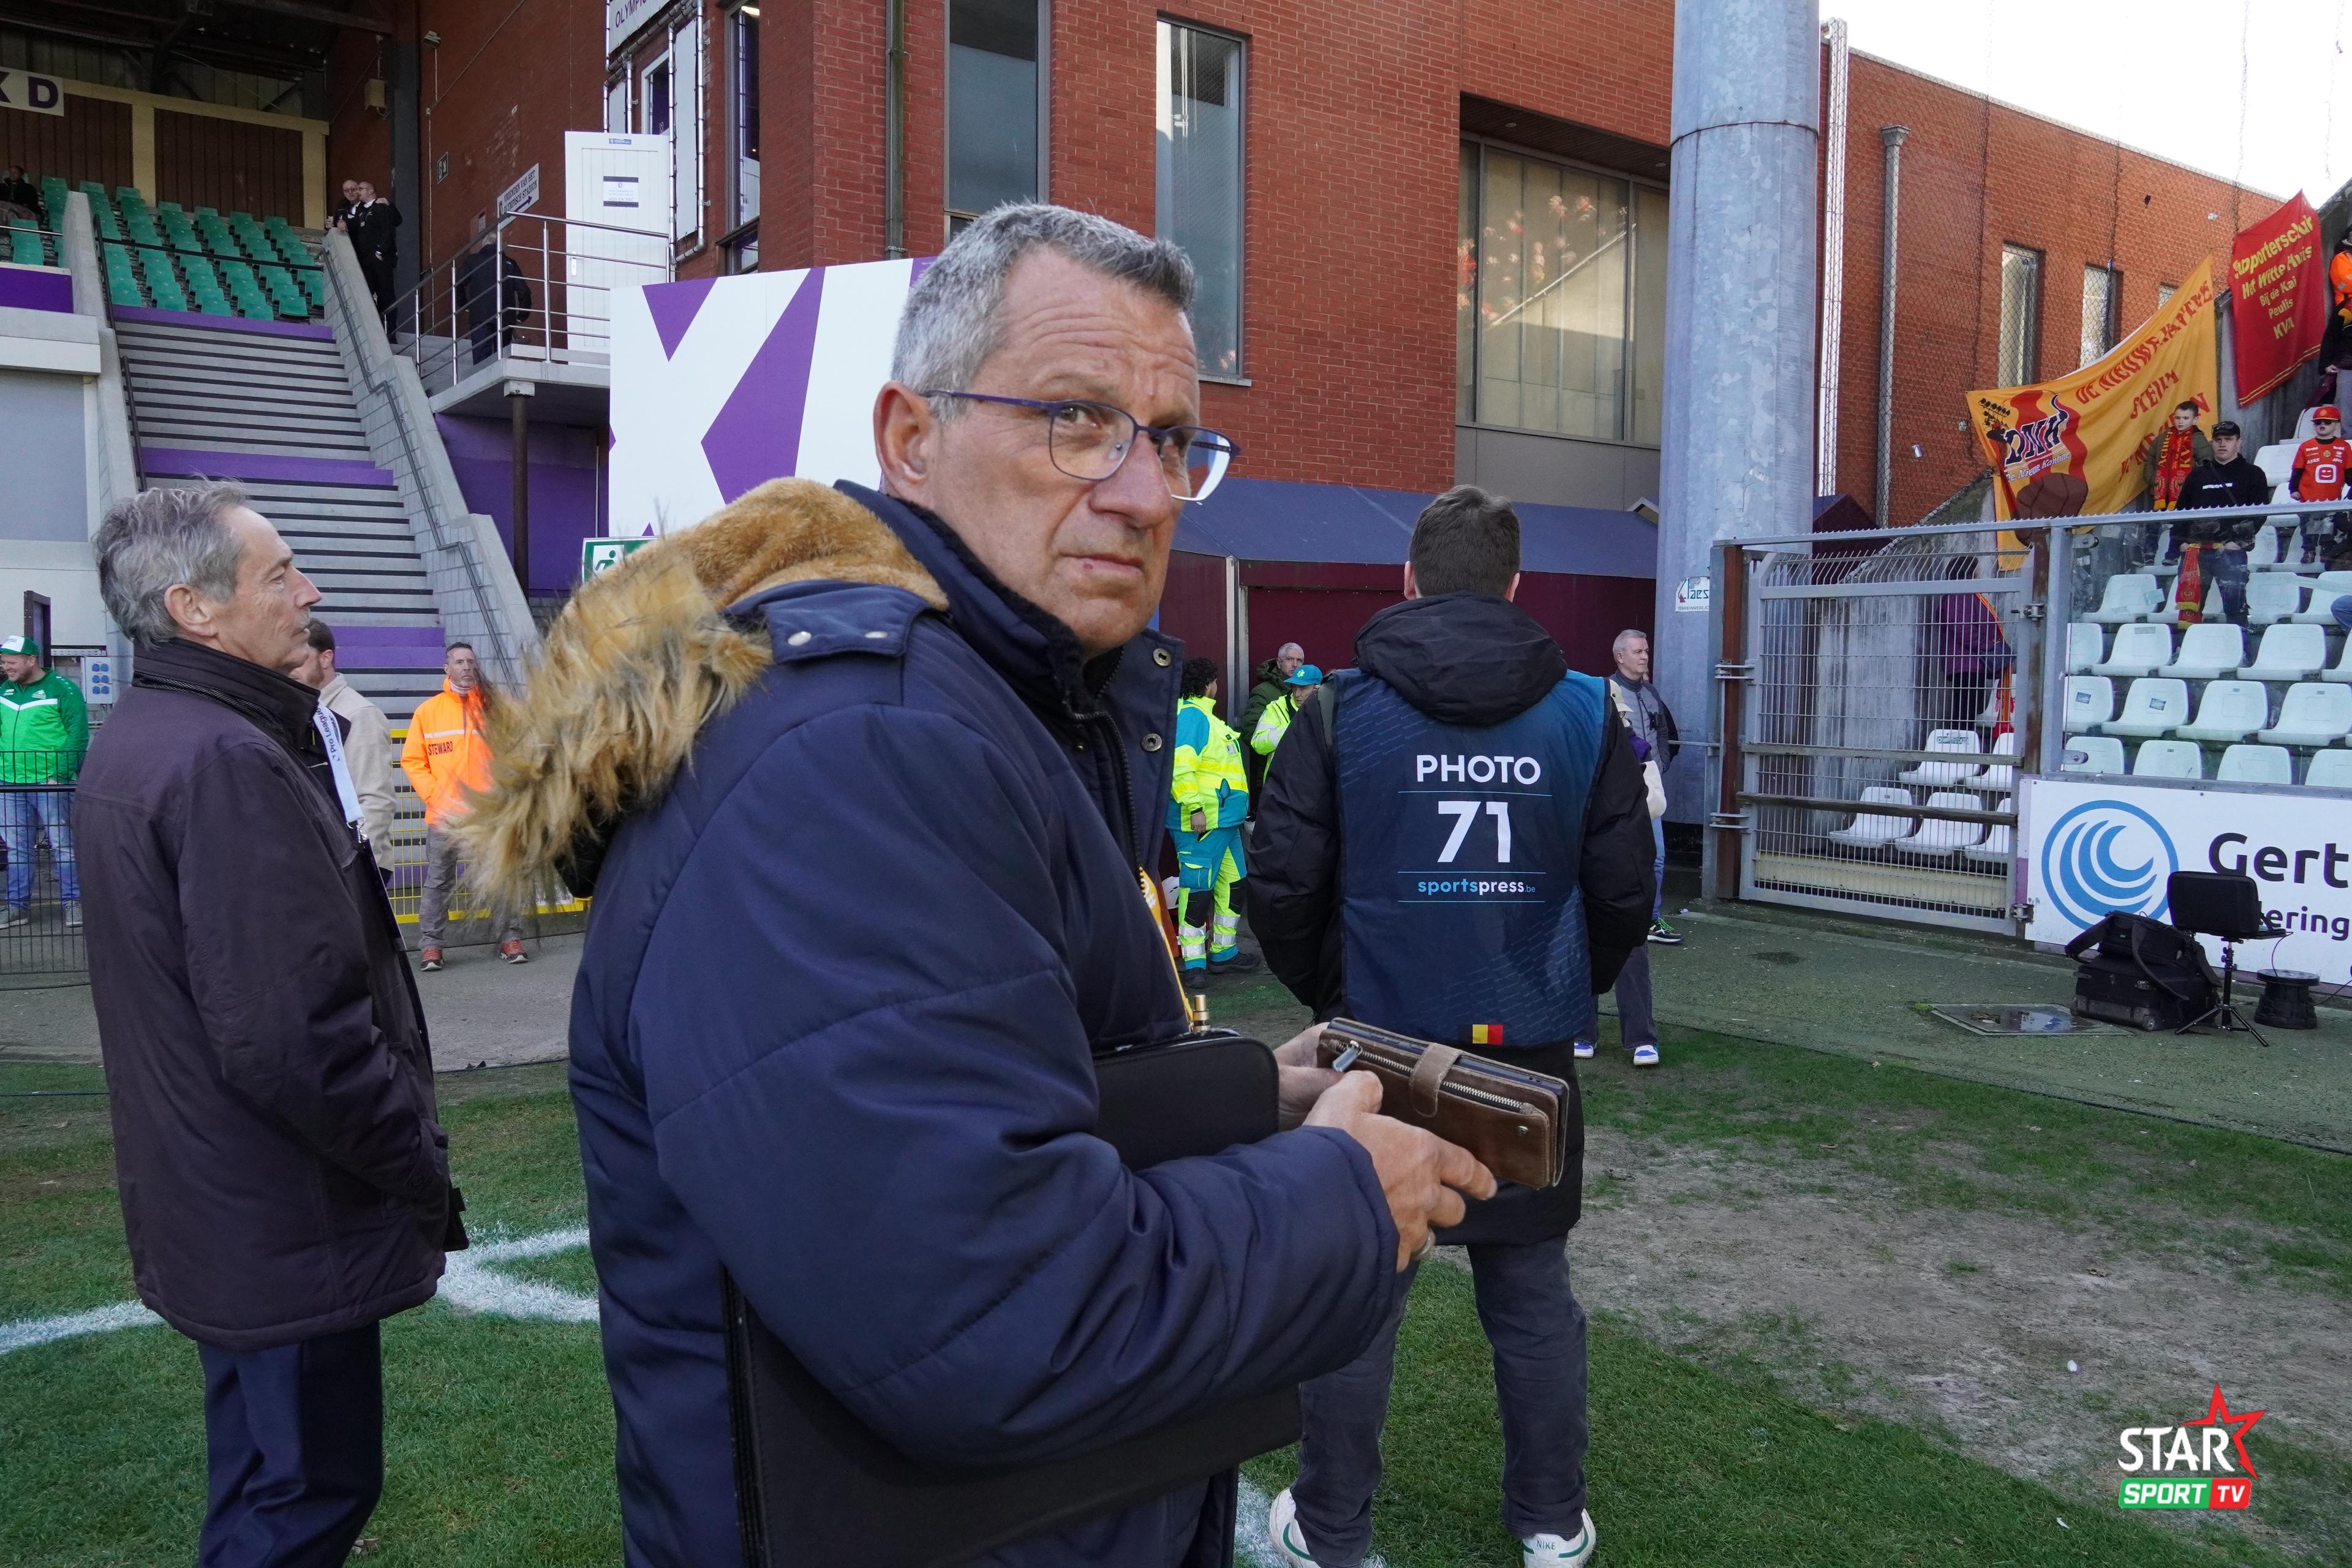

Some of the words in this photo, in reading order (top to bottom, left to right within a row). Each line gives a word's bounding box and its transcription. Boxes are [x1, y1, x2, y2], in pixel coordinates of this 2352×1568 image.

[615, 0, 646, 28] OLYMP
[28, 76, 58, 109] D
[503, 183, 520, 202] VRIENDEN
[522, 181, 537, 198] STADION
[2258, 262, 2285, 288] Witte
[2260, 292, 2271, 306] Bij
[2270, 287, 2280, 300] de
[2280, 276, 2297, 293] Kai
[2269, 298, 2294, 318] Peulis
[2076, 382, 2101, 405] DE
[2041, 452, 2071, 469] Kantine
[428, 741, 453, 756] STEWARD
[1416, 754, 1542, 785] PHOTO
[1437, 801, 1512, 864] 71
[2208, 832, 2350, 889] Gert
[1417, 878, 1536, 896] sportspress.be
[2264, 905, 2350, 941] ering
[1536, 1540, 1556, 1550] NIKE
